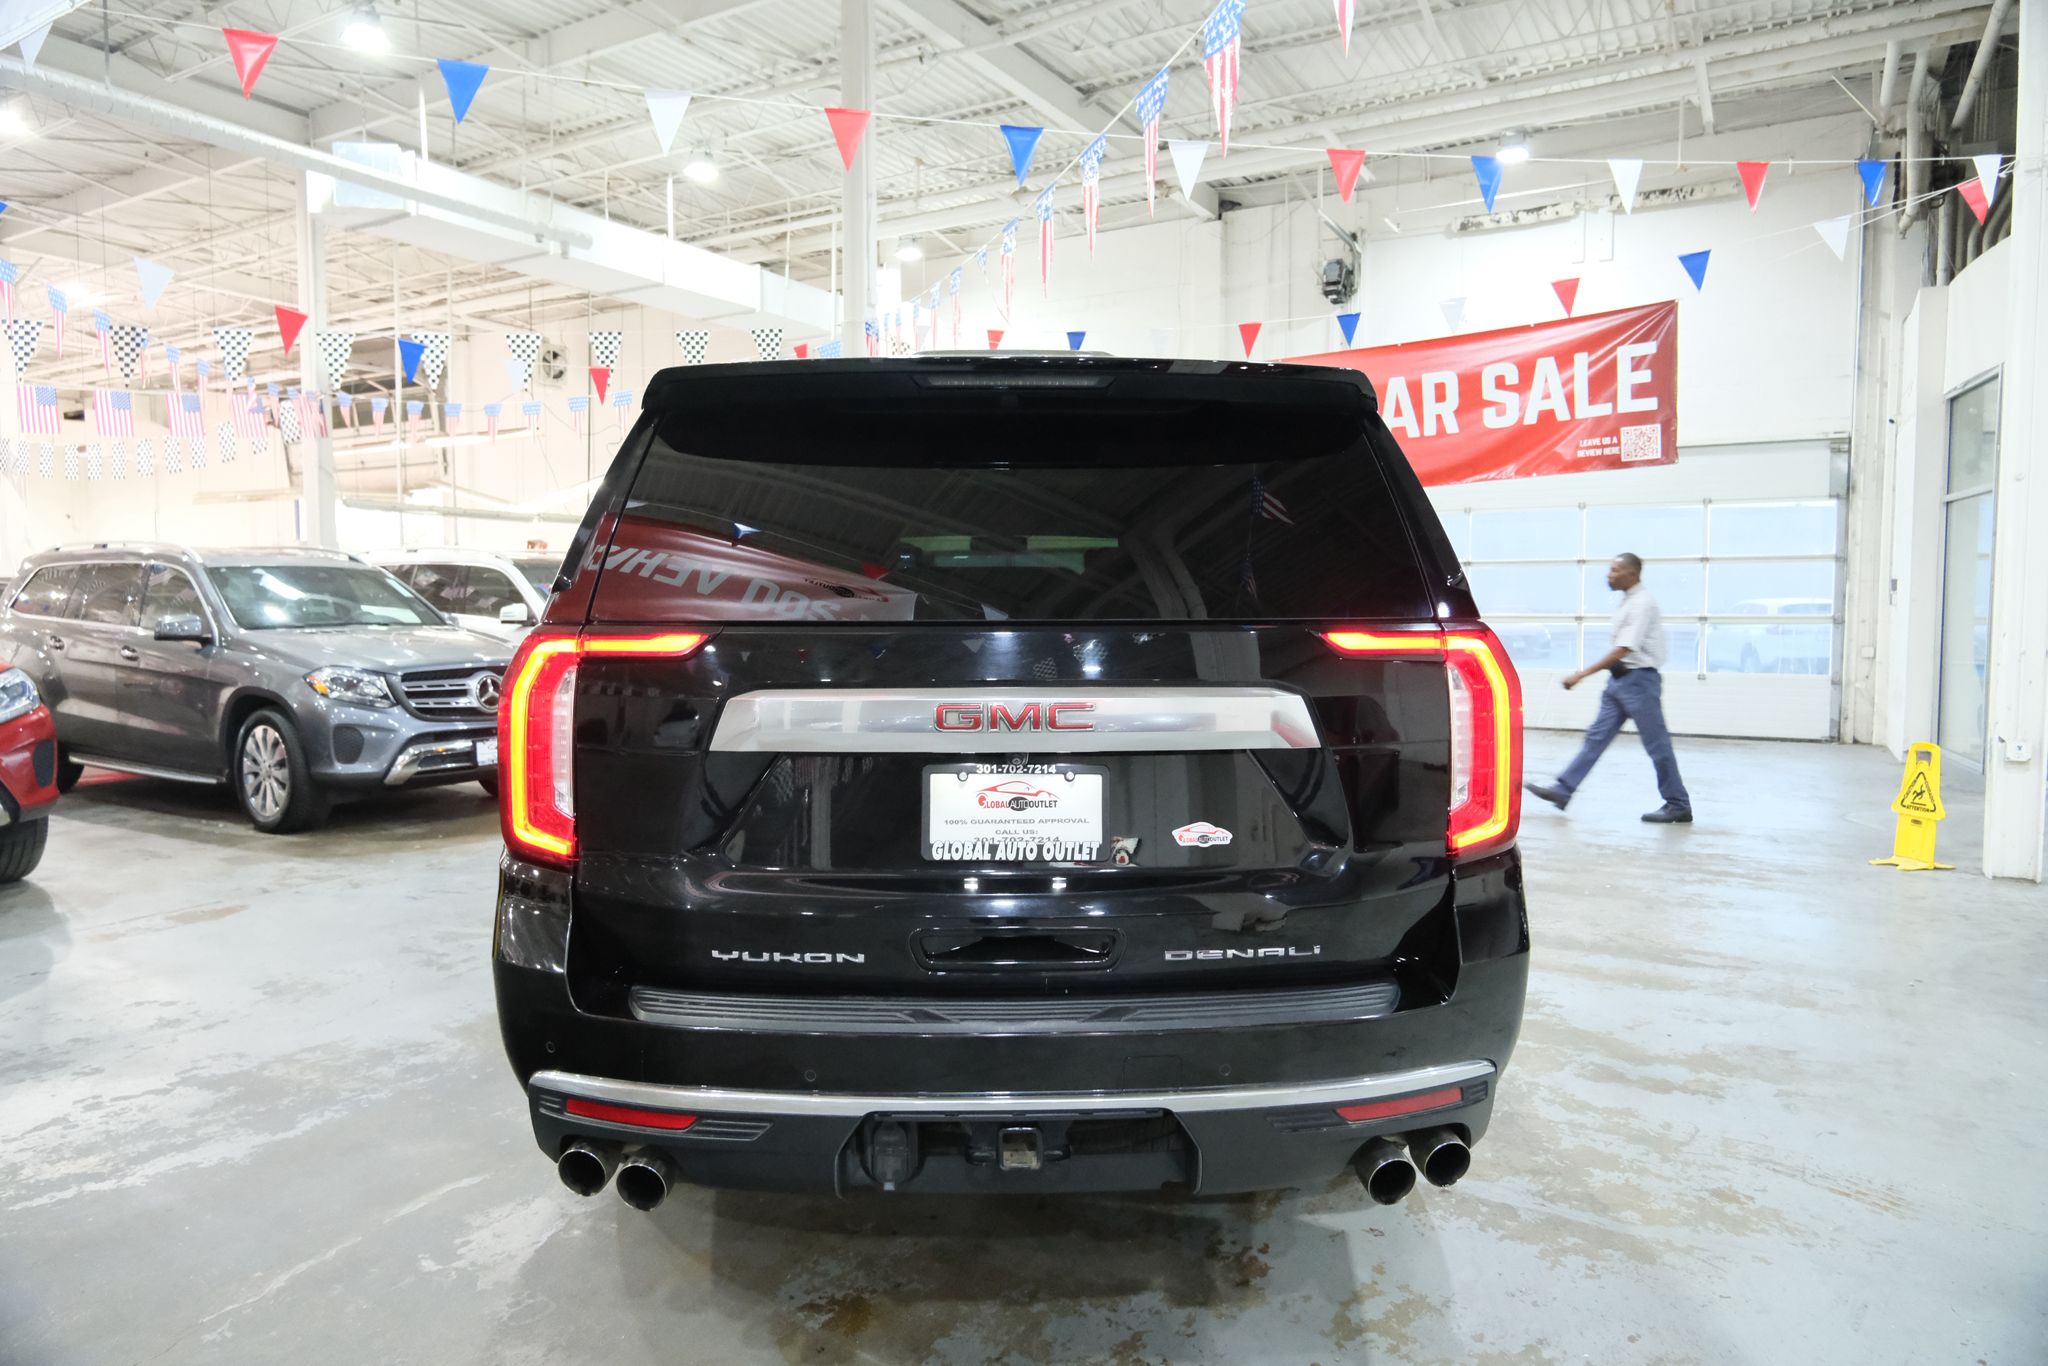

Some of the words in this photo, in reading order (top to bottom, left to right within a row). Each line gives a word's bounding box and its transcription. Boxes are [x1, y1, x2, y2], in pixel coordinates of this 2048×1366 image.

[1381, 370, 1460, 438] AR
[1481, 341, 1659, 429] SALE
[1579, 437, 1601, 447] LEAVE
[1602, 436, 1611, 445] US
[1612, 436, 1618, 444] A
[1576, 448, 1602, 458] REVIEW
[934, 702, 1096, 732] GMC
[976, 764, 1057, 774] 301-702-7214
[931, 840, 992, 861] GLOBAL
[995, 841, 1038, 861] AUTO
[1042, 841, 1100, 861] OUTLET
[711, 950, 865, 963] YUKON
[1164, 945, 1321, 961] DENALI
